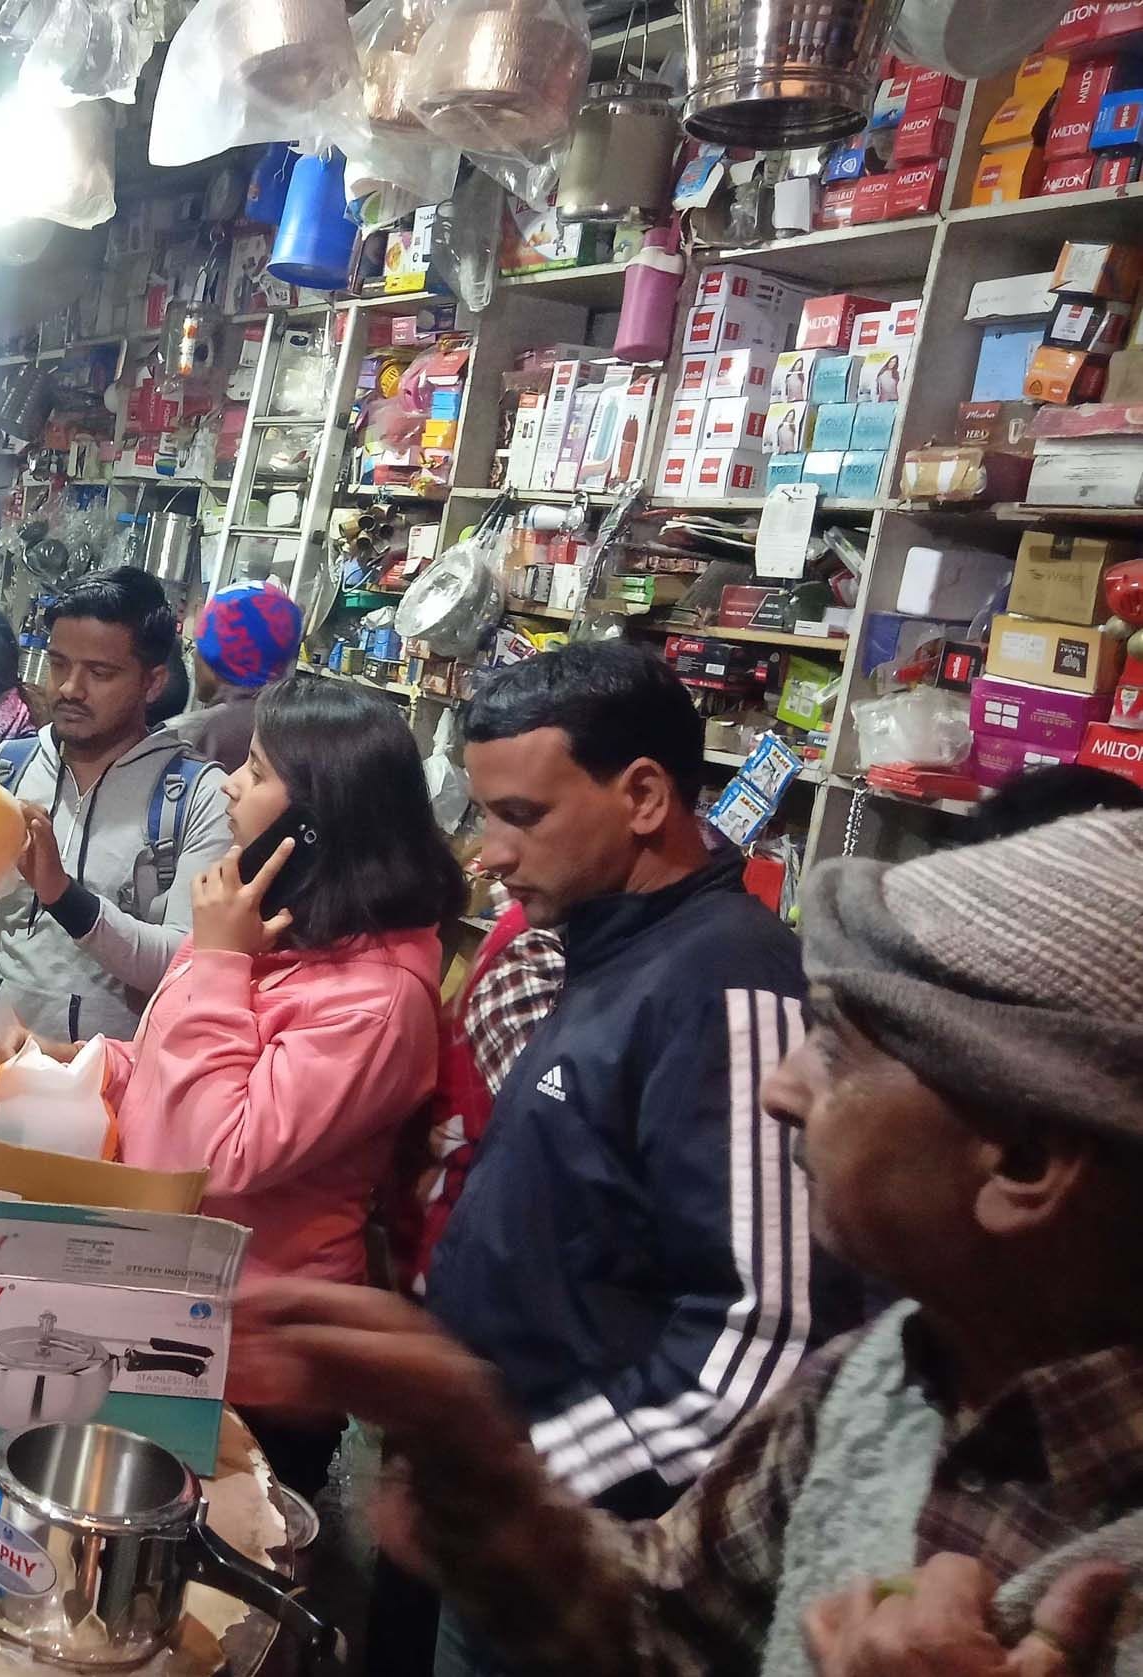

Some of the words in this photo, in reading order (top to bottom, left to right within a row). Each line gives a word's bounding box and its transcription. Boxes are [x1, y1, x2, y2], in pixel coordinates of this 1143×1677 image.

[1060, 4, 1099, 26] ILTON
[902, 119, 930, 132] MILTON
[1051, 122, 1091, 139] MILTON
[898, 170, 931, 185] MILTON
[1044, 173, 1086, 193] MILTON
[861, 183, 888, 193] MILTON
[692, 322, 710, 332] cello
[686, 370, 703, 379] cello
[952, 656, 962, 678] cello
[536, 1081, 566, 1101] adidas
